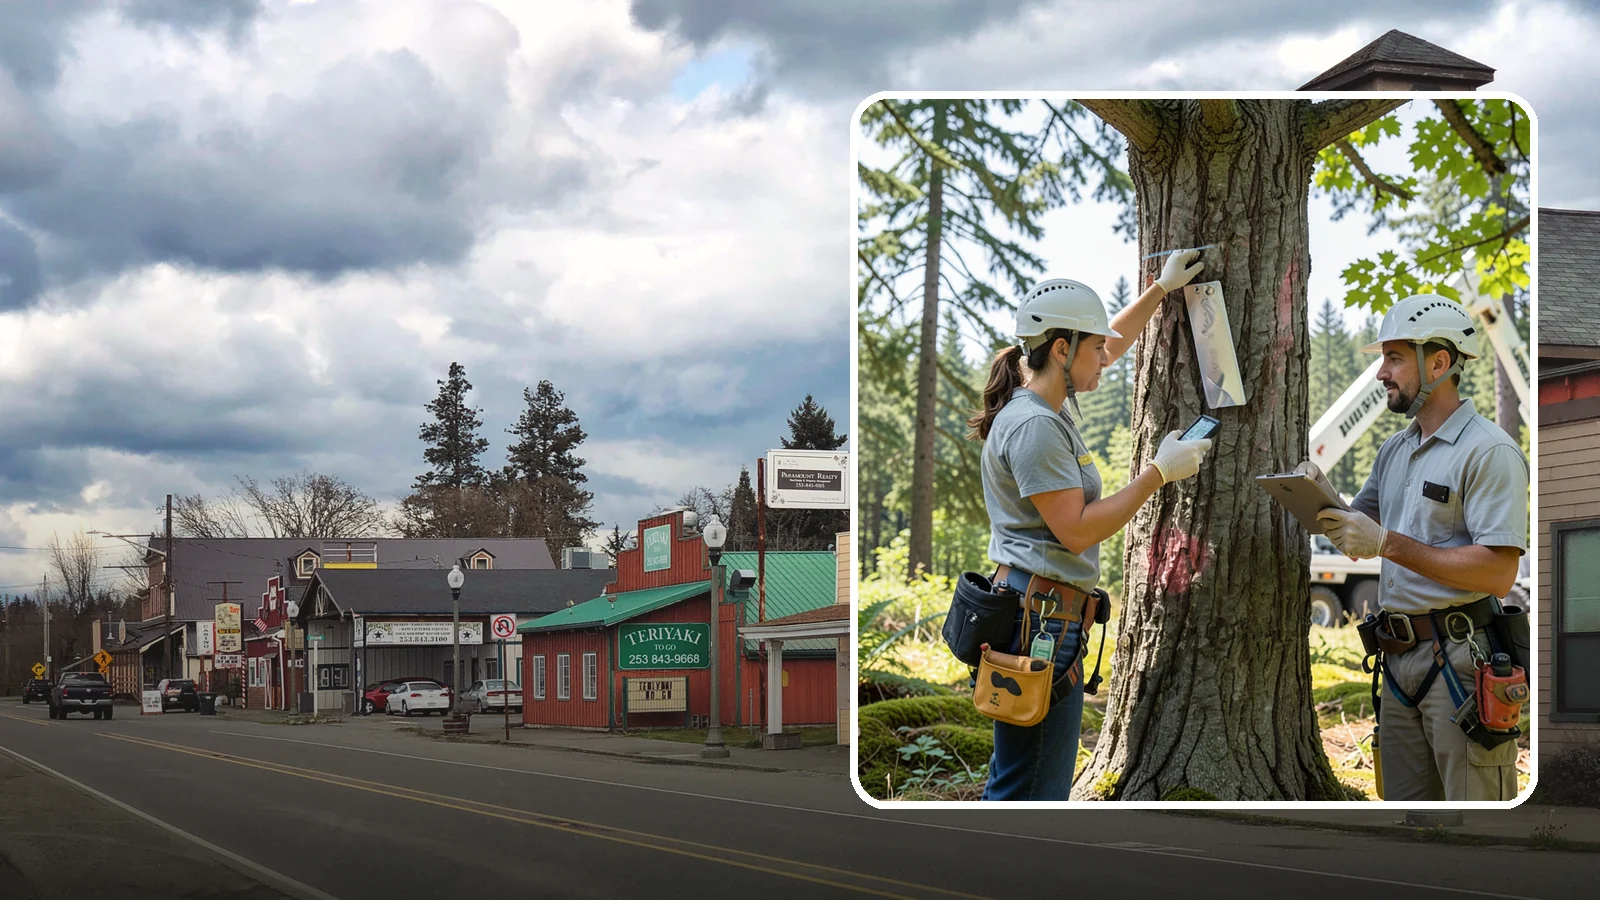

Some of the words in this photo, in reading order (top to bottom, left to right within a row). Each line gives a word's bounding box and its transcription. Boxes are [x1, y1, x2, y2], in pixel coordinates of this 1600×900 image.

[624, 627, 703, 646] TERIYAKI
[654, 643, 664, 651] TO
[665, 643, 676, 651] GO
[628, 654, 649, 665] 253
[651, 653, 700, 664] 843-9668
